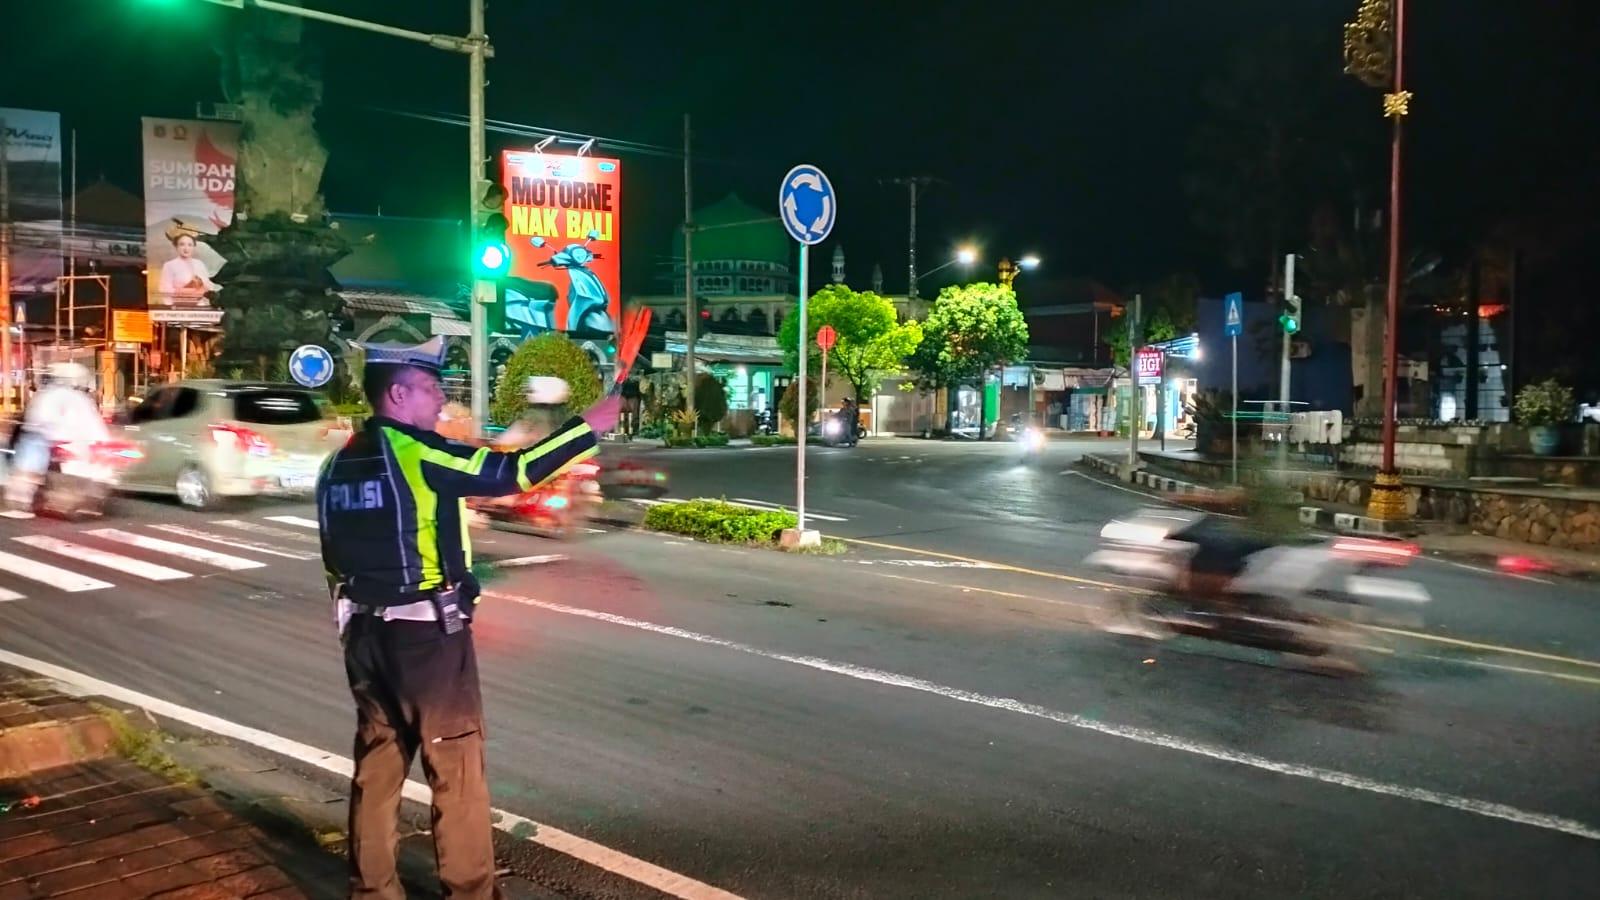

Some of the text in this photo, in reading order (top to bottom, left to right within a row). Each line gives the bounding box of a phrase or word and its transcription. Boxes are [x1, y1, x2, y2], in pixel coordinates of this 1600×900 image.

[150, 160, 236, 178] SUMPAH
[151, 176, 235, 193] PEMUDA
[511, 176, 613, 211] MOTORNE
[511, 205, 613, 241] NAK BALI
[330, 480, 384, 511] POLISI
